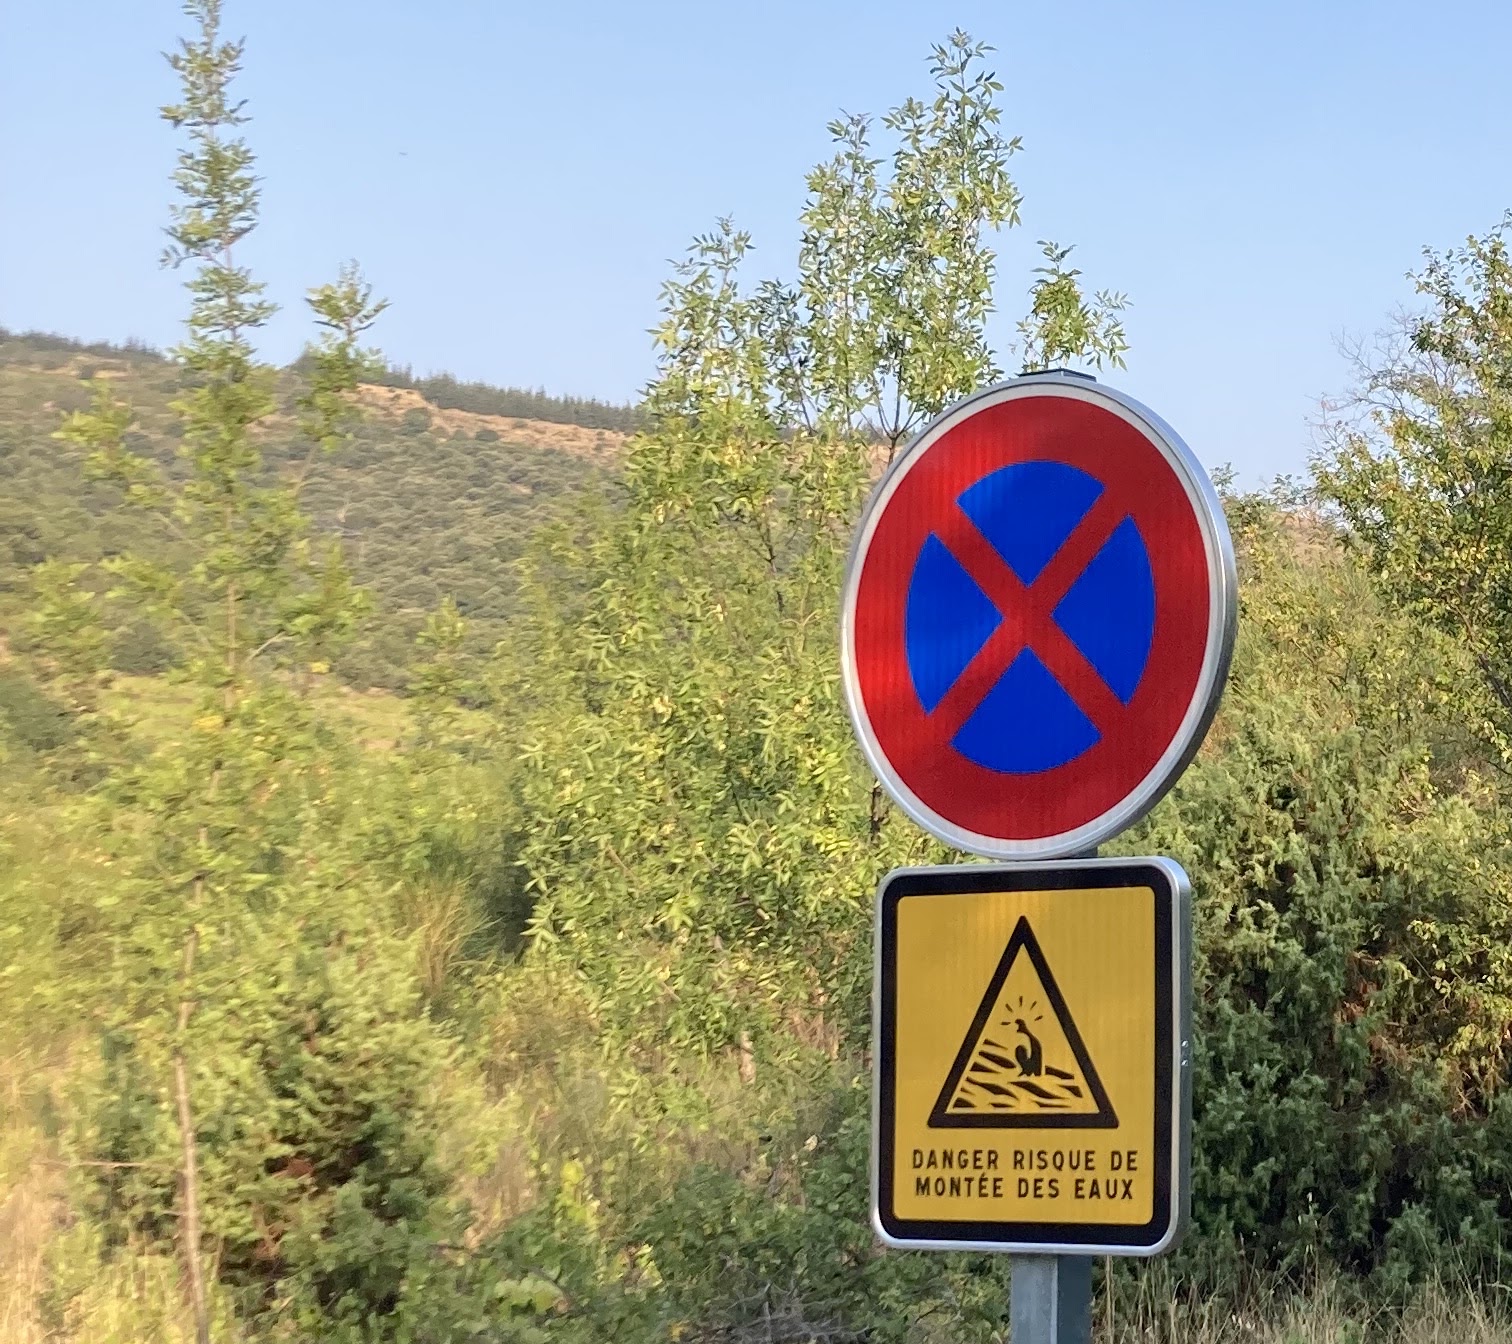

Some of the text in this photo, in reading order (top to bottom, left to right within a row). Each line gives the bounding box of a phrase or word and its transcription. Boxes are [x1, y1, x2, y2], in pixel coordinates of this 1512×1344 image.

[912, 1148, 1138, 1171] DANGER RISQUE DE
[915, 1173, 1133, 1200] MONTÉE DES EAUX
